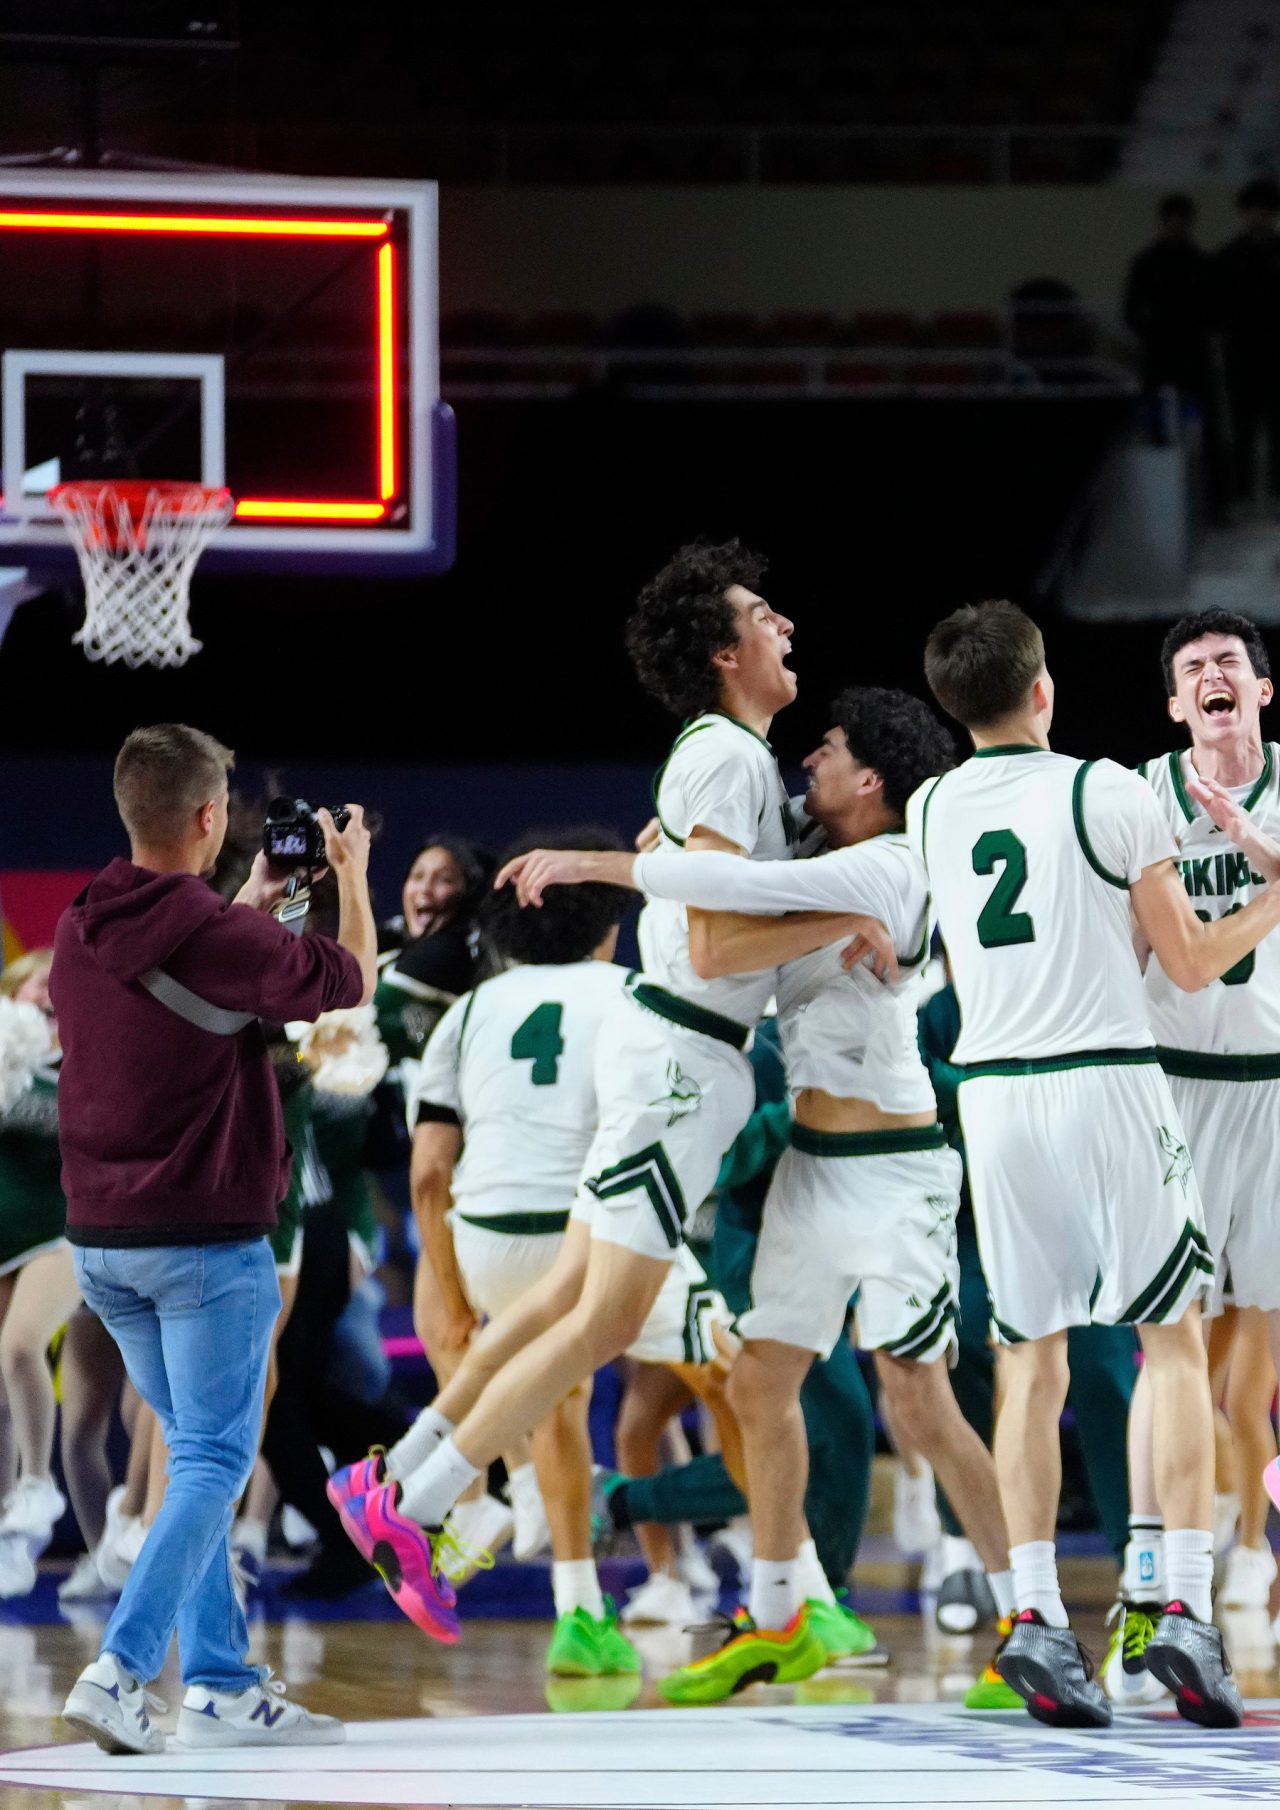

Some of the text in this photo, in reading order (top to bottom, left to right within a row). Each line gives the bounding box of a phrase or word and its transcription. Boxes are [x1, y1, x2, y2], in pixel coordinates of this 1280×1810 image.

[971, 828, 1036, 949] 2
[1173, 852, 1267, 896] IKIN
[510, 1002, 564, 1086] 4
[249, 1699, 285, 1729] N
